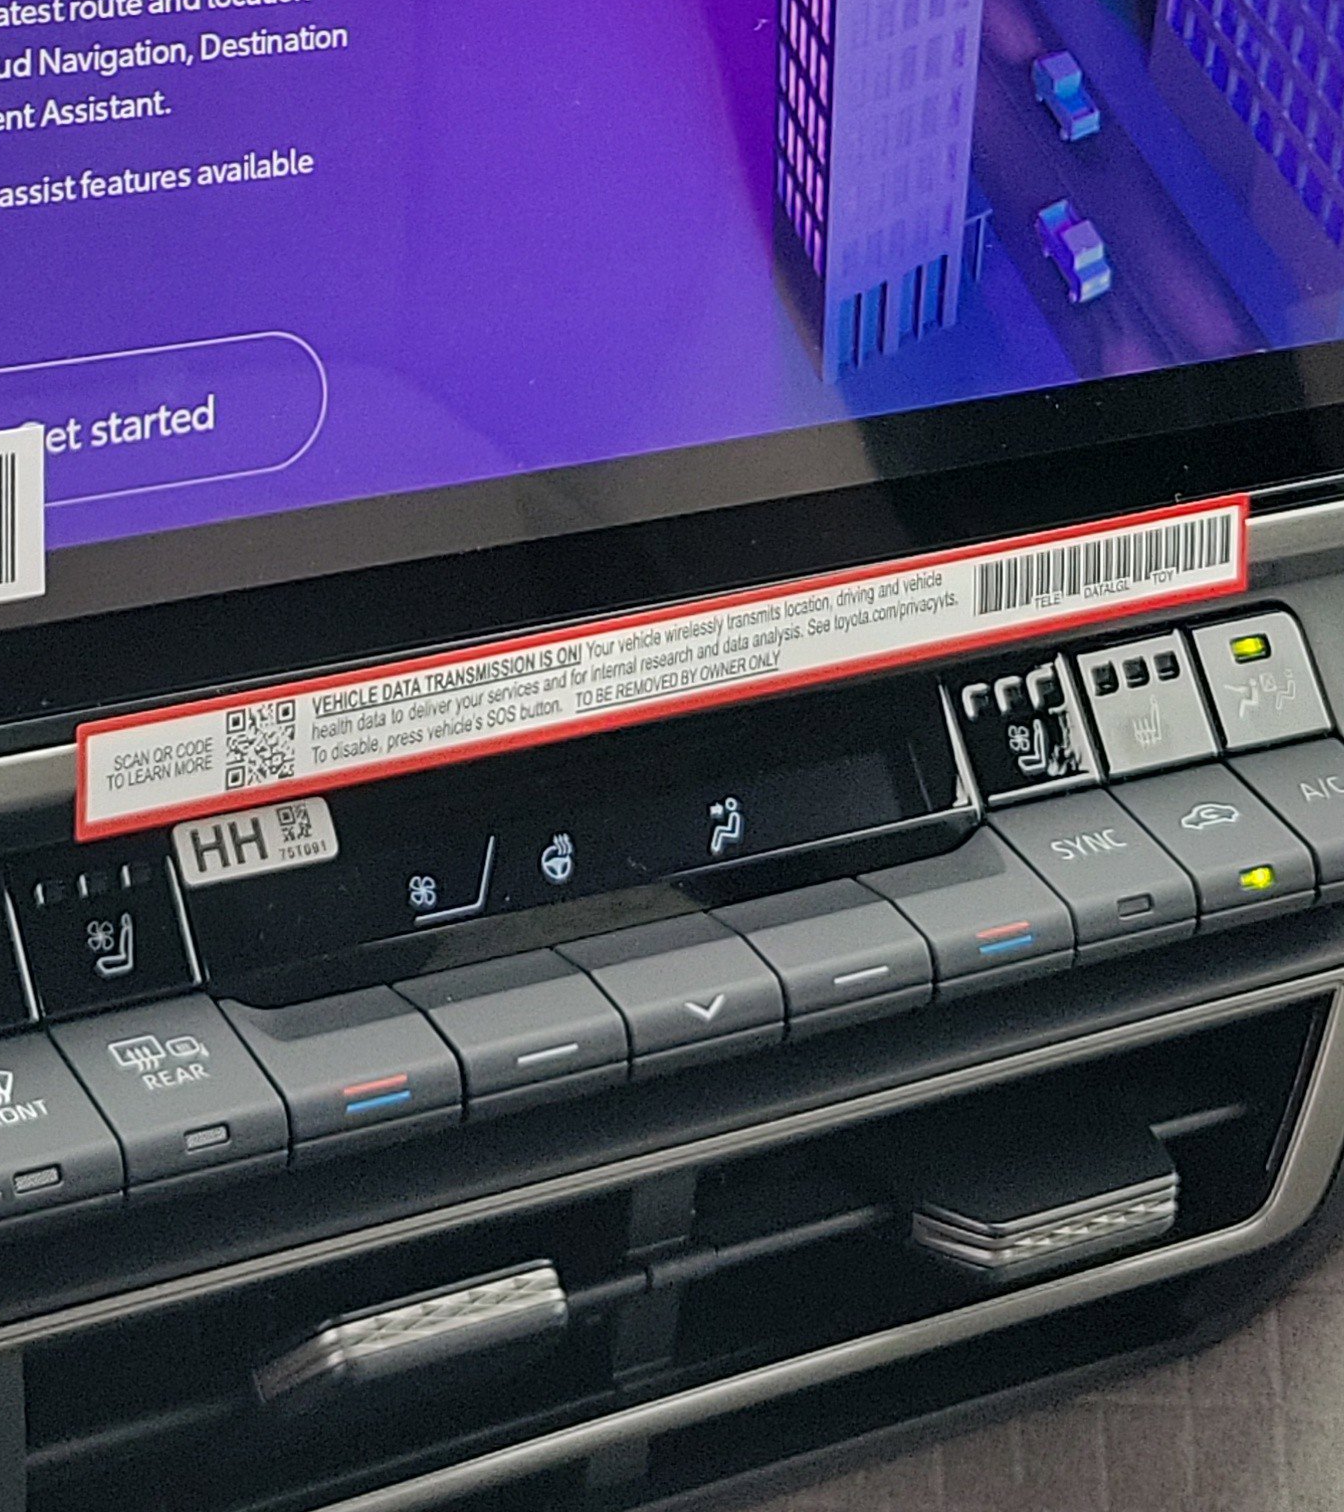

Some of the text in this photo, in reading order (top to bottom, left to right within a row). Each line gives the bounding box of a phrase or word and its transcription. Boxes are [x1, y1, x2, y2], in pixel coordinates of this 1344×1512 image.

[38, 37, 195, 77] Navigation,
[200, 23, 348, 62] Destination
[39, 90, 172, 128] Assistant.
[80, 163, 192, 198] features
[197, 149, 315, 186] available
[91, 393, 215, 448] started
[1035, 592, 1062, 609] TELE
[1152, 569, 1174, 585] TOY
[312, 685, 378, 715] VEHICLE
[382, 678, 421, 702] DATA
[427, 654, 535, 691] TRANSMISSION
[539, 649, 553, 667] IS
[586, 637, 614, 660] Your
[618, 629, 661, 654] vehicle
[665, 616, 724, 644] wirelessly
[727, 605, 782, 631] transmits
[784, 594, 834, 620] location,
[837, 585, 875, 610] driving
[878, 577, 900, 598] and
[903, 570, 942, 594] vehicle
[312, 592, 958, 740] health data to deliver your services and for internal research and data analysis. See toyota.com/privacyvts.
[312, 649, 781, 764] To disable, press vehicle's SOS button. TO BE REMOVED BY OWNER ONLY
[106, 754, 213, 791] TO LEARN MORE
[114, 737, 213, 772] SCAN QR CODE
[189, 816, 269, 873] HH
[1051, 827, 1127, 861] SYNC
[143, 1061, 210, 1091] REAR
